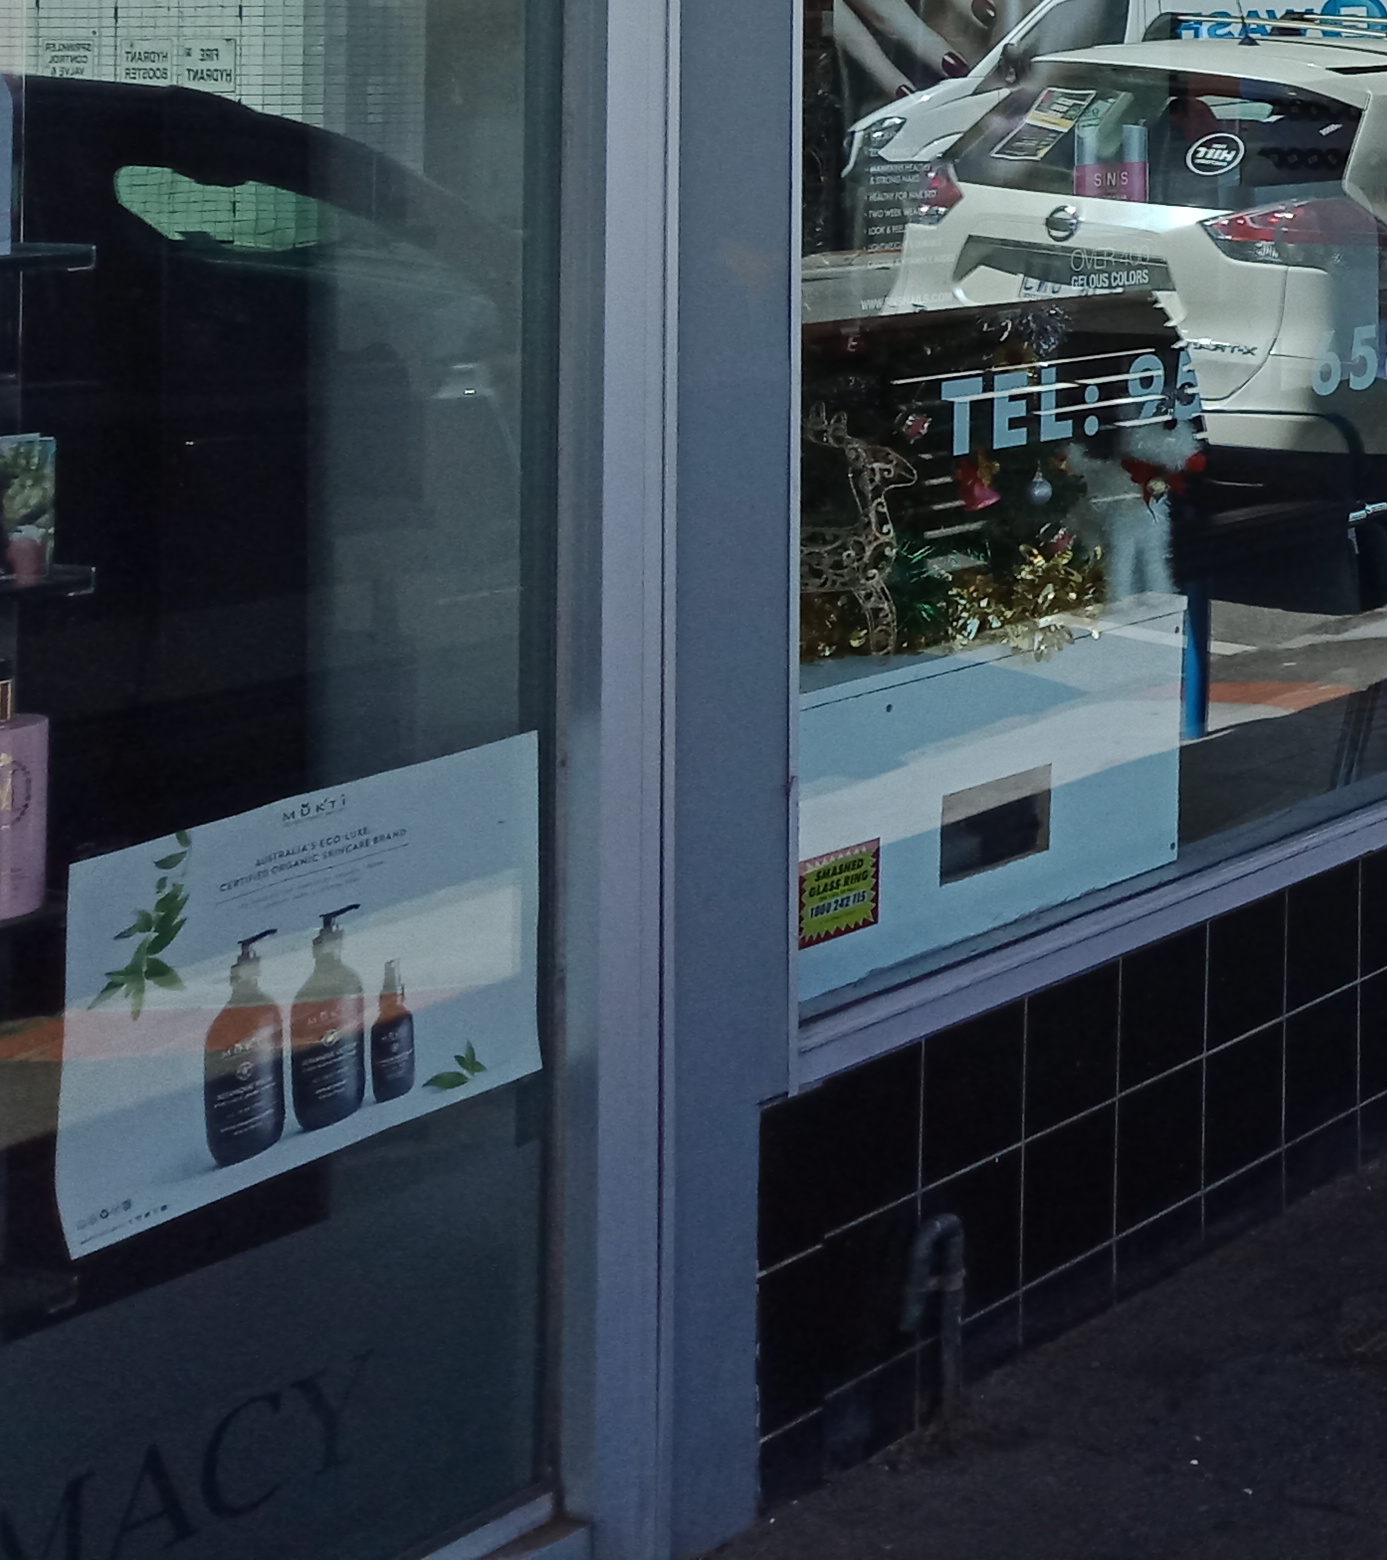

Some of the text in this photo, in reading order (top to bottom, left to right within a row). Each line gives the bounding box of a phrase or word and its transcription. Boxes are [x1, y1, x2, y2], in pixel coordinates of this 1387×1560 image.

[1070, 247, 1114, 271] OVER
[1111, 269, 1149, 286] COLORS
[941, 364, 1099, 456] TEL:
[219, 869, 270, 892] CERTIFIED
[271, 854, 319, 875] ORGANIC
[322, 839, 370, 860] SKINCARE
[372, 829, 407, 845] BRAND
[815, 858, 863, 881] SMASHED
[809, 880, 840, 897] GLASS
[843, 870, 868, 887] RING
